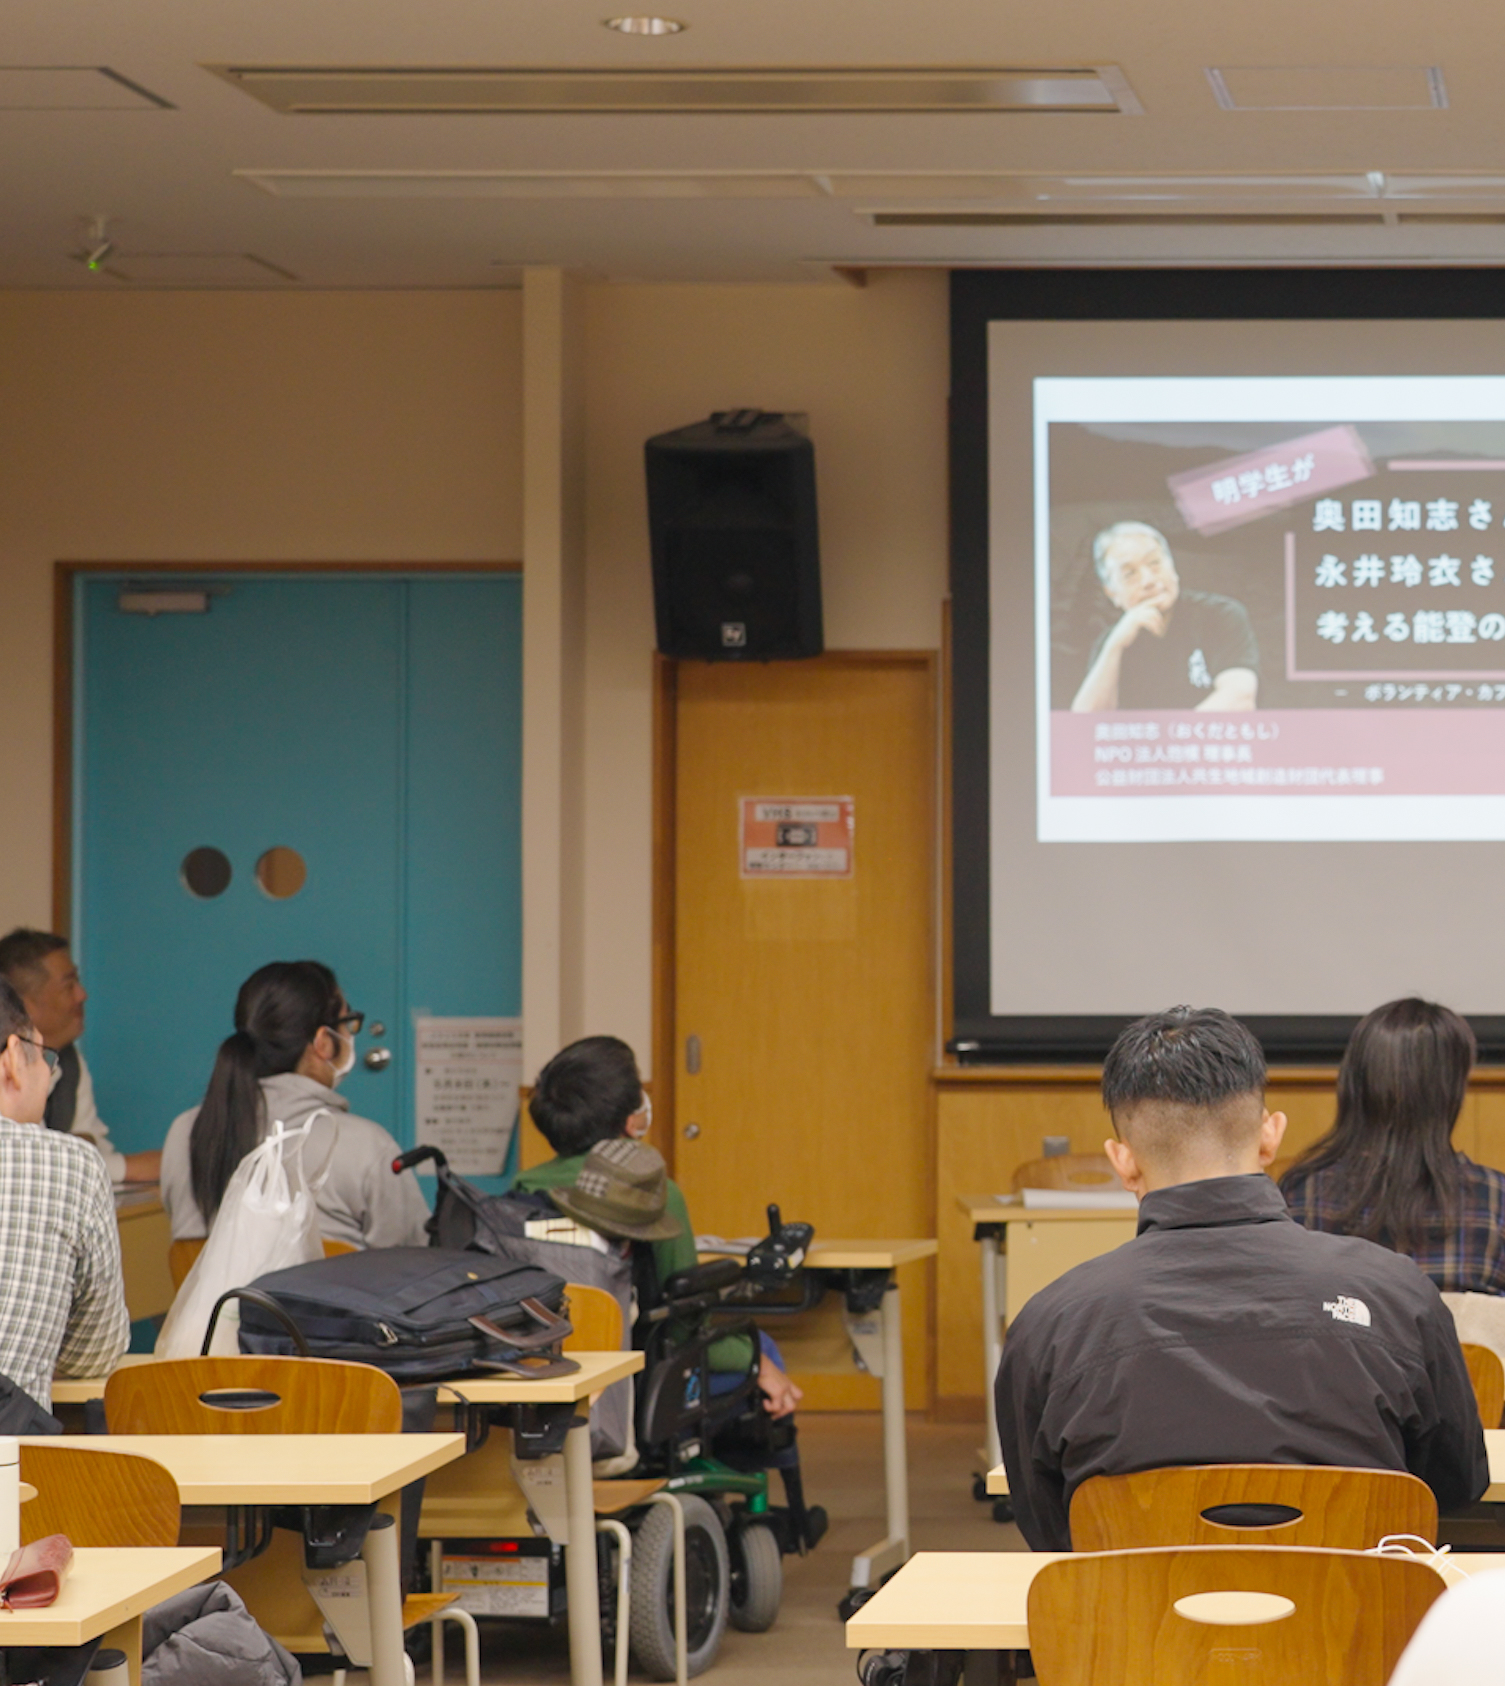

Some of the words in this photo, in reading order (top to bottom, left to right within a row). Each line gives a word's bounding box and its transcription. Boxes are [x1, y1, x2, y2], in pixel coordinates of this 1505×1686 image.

[1211, 452, 1315, 505] 明学生が
[1095, 746, 1132, 762] NPO
[1322, 1301, 1354, 1315] NORTH
